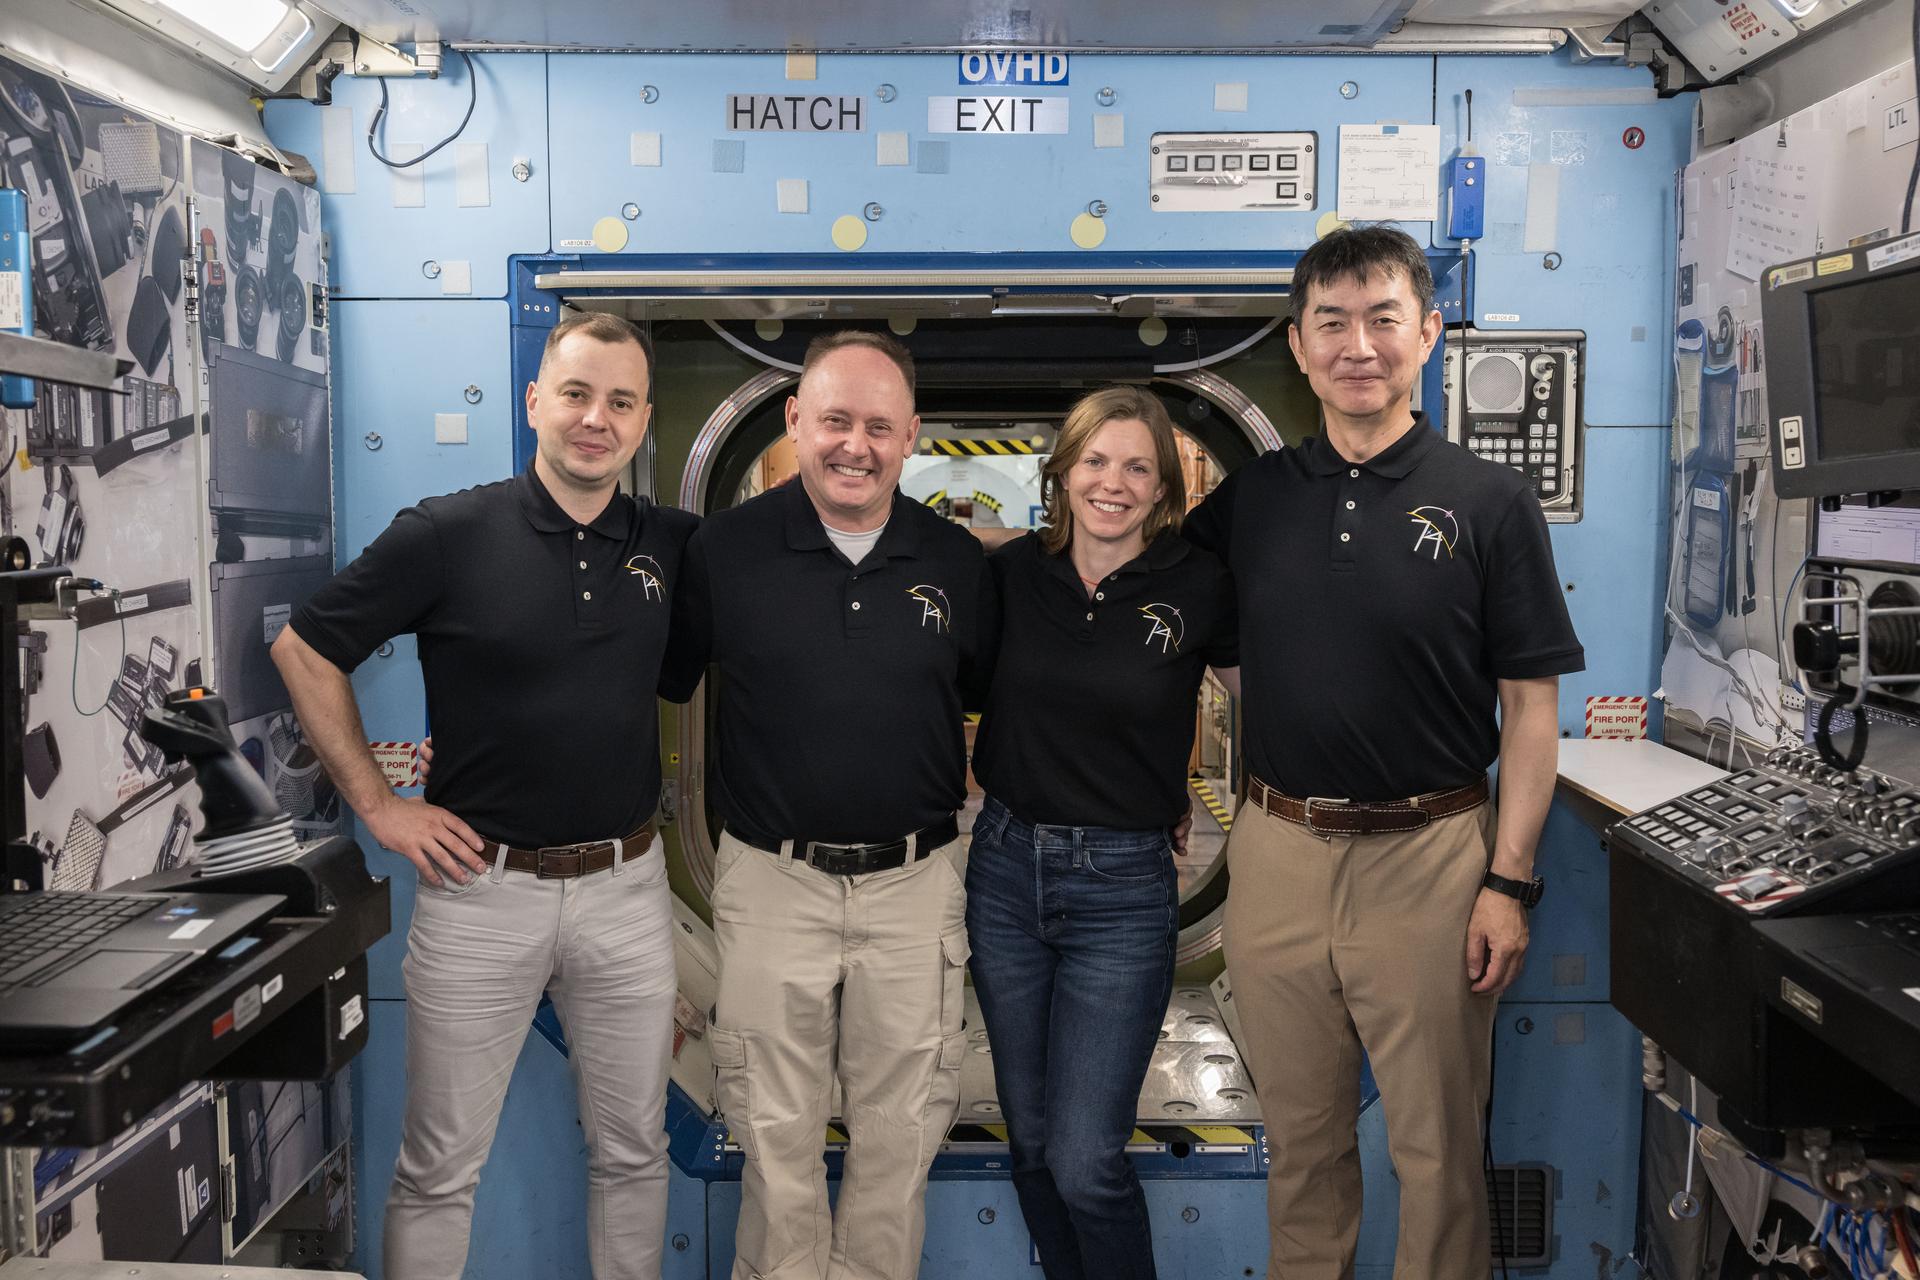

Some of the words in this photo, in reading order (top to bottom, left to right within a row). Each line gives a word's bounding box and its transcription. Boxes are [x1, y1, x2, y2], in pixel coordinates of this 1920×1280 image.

[961, 53, 1068, 82] OVHD
[733, 96, 860, 131] HATCH
[957, 98, 1043, 132] EXIT
[1888, 107, 1908, 130] LTL
[1593, 715, 1613, 723] FIRE
[1615, 715, 1639, 723] PORT
[386, 761, 410, 769] PORT
